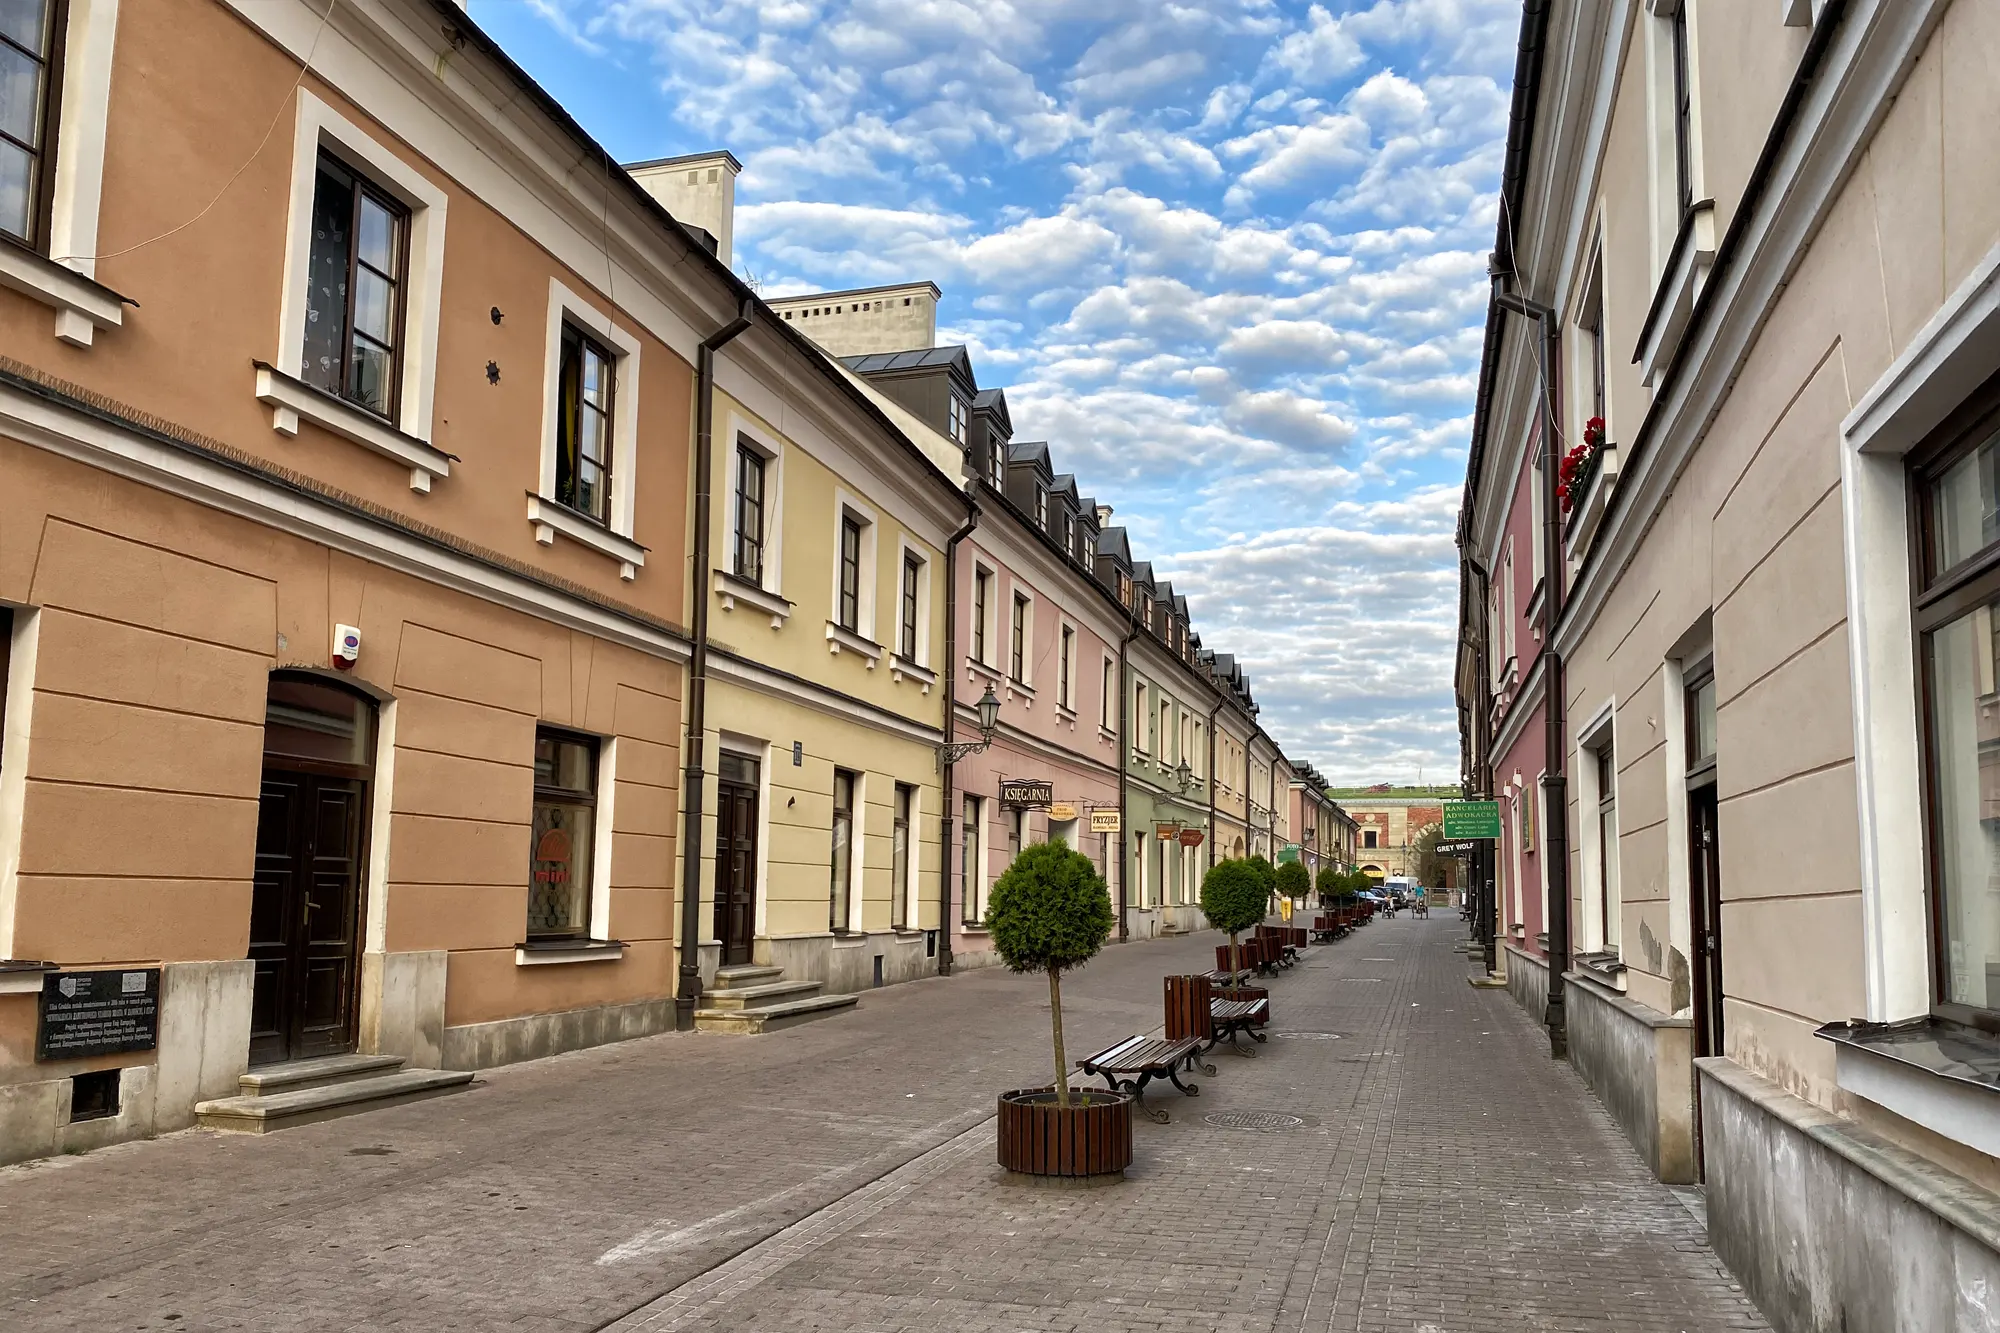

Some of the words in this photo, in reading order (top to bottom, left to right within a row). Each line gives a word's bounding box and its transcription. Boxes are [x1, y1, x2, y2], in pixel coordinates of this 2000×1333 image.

[1004, 787, 1050, 802] KSIĘGARNIA
[1093, 816, 1118, 825] FRYZJER
[1436, 844, 1455, 853] GREY
